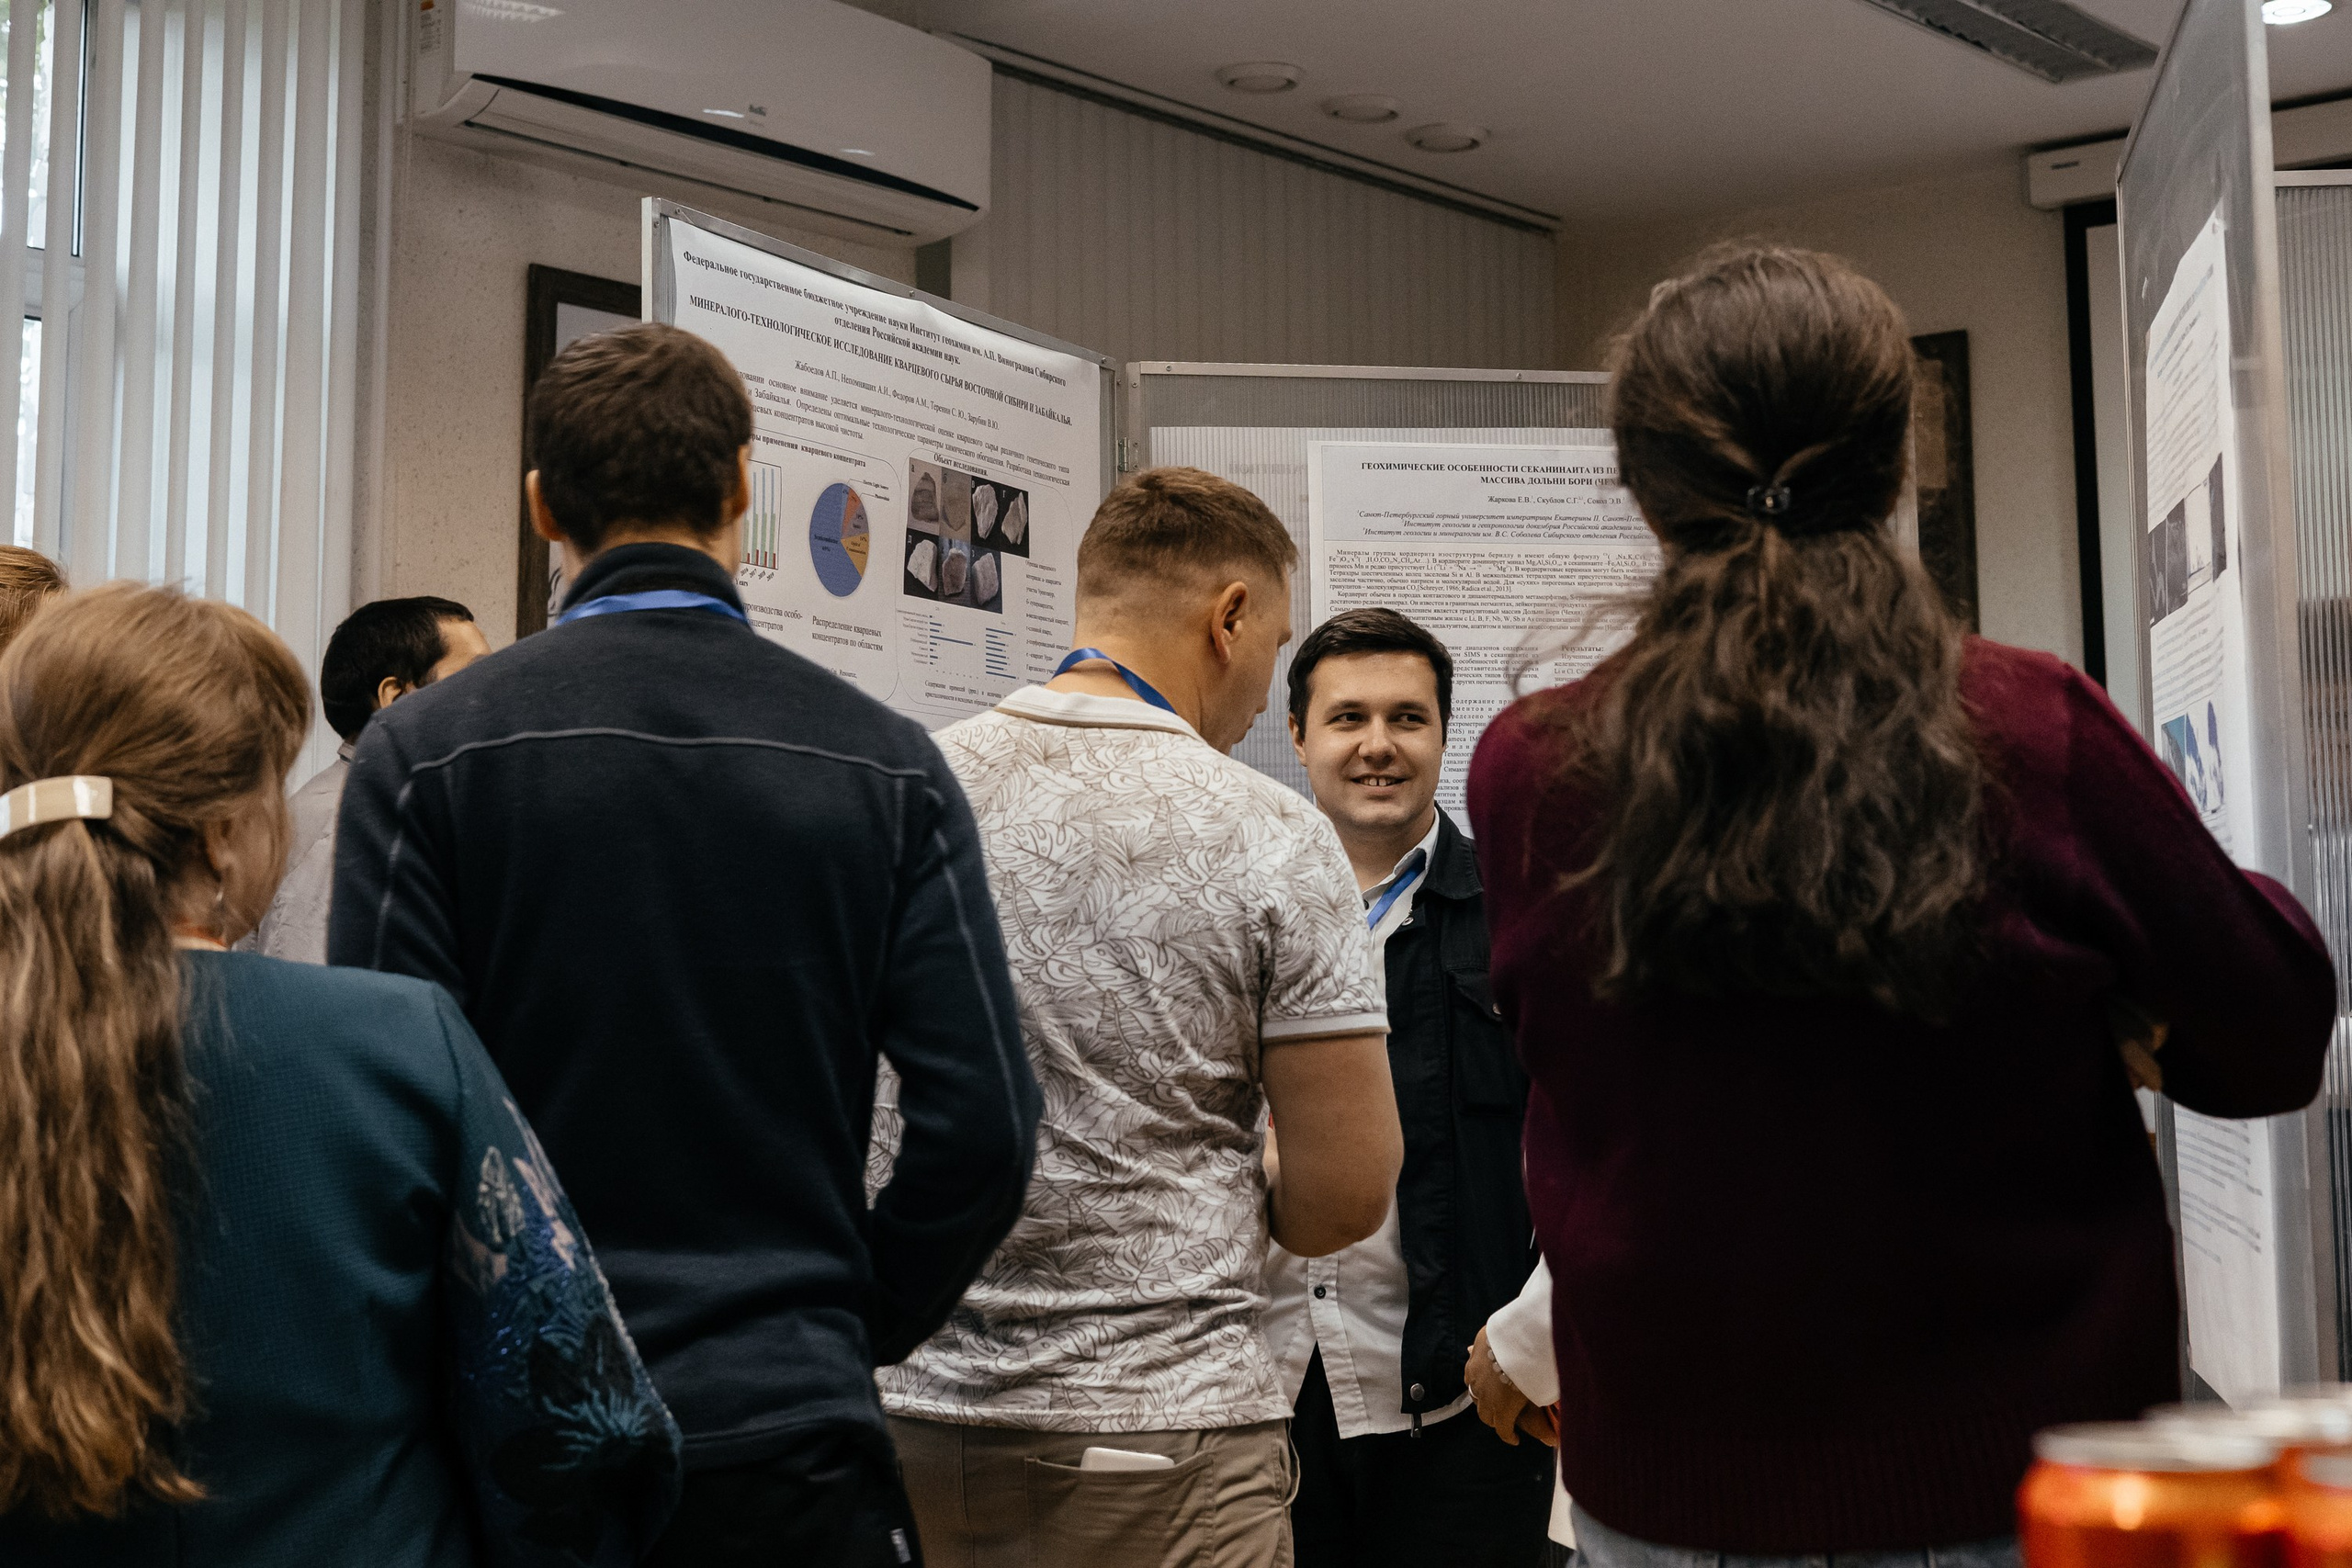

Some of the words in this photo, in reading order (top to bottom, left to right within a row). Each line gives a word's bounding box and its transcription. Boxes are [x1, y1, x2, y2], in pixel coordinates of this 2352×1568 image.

[683, 252, 739, 276] Федеральное
[740, 271, 802, 296] государственное
[803, 288, 843, 310] бюджетное
[845, 305, 887, 323] учреждение
[888, 318, 909, 331] науки
[910, 322, 940, 343] Институт
[942, 336, 970, 352] геохимии
[972, 346, 982, 356] им.
[983, 349, 997, 361] А.П.
[998, 354, 1034, 374] Виноградова
[1035, 367, 1066, 386] Сибирского
[834, 317, 870, 334] отделения
[872, 326, 910, 347] Российской
[911, 343, 943, 358] академии
[944, 353, 960, 365] наук.
[689, 296, 832, 345] МИНЕРАЛОГО-ТЕХНОЛОГИЧЕСКОЕ
[833, 339, 893, 366] ИССЛЕДОВАНИЕ
[894, 358, 939, 380] КВАРЦЕВОГО
[940, 373, 963, 388] СЫРЬЯ
[964, 381, 1003, 401] ВОСТОЧНОЙ
[1004, 395, 1029, 410] СИБИРИ
[1035, 405, 1072, 425] ЗАБАЙКАЛЬЯ.
[795, 360, 824, 376] Жабоедов
[825, 369, 840, 381] А.П.,
[841, 374, 876, 391] Непомнящих
[892, 389, 914, 403] Федоров
[754, 388, 791, 405] Забайкалья.
[796, 399, 831, 416] Определены
[833, 412, 870, 427] оптимальные
[872, 423, 915, 440] технологические
[917, 435, 944, 449] параметры
[944, 444, 975, 457] химического
[768, 379, 797, 392] основное
[799, 388, 828, 400] внимание
[831, 397, 857, 410] уделяется
[860, 406, 935, 432] минералого-технологической
[937, 428, 955, 438] оценке
[956, 434, 983, 446] кварцевого
[774, 411, 814, 425] концентратов
[815, 421, 839, 433] высокой
[840, 428, 864, 439] чистоты.
[762, 436, 798, 449] применения
[801, 446, 832, 457] кварцевого
[833, 454, 866, 467] концентрата
[933, 453, 952, 466] Объект
[953, 461, 988, 476] исследования.
[735, 579, 748, 588] Years
[784, 610, 803, 619] особо-
[812, 615, 853, 631] Распределение
[854, 626, 881, 637] кварцевых
[812, 633, 849, 645] концентратов
[857, 639, 883, 651] областям
